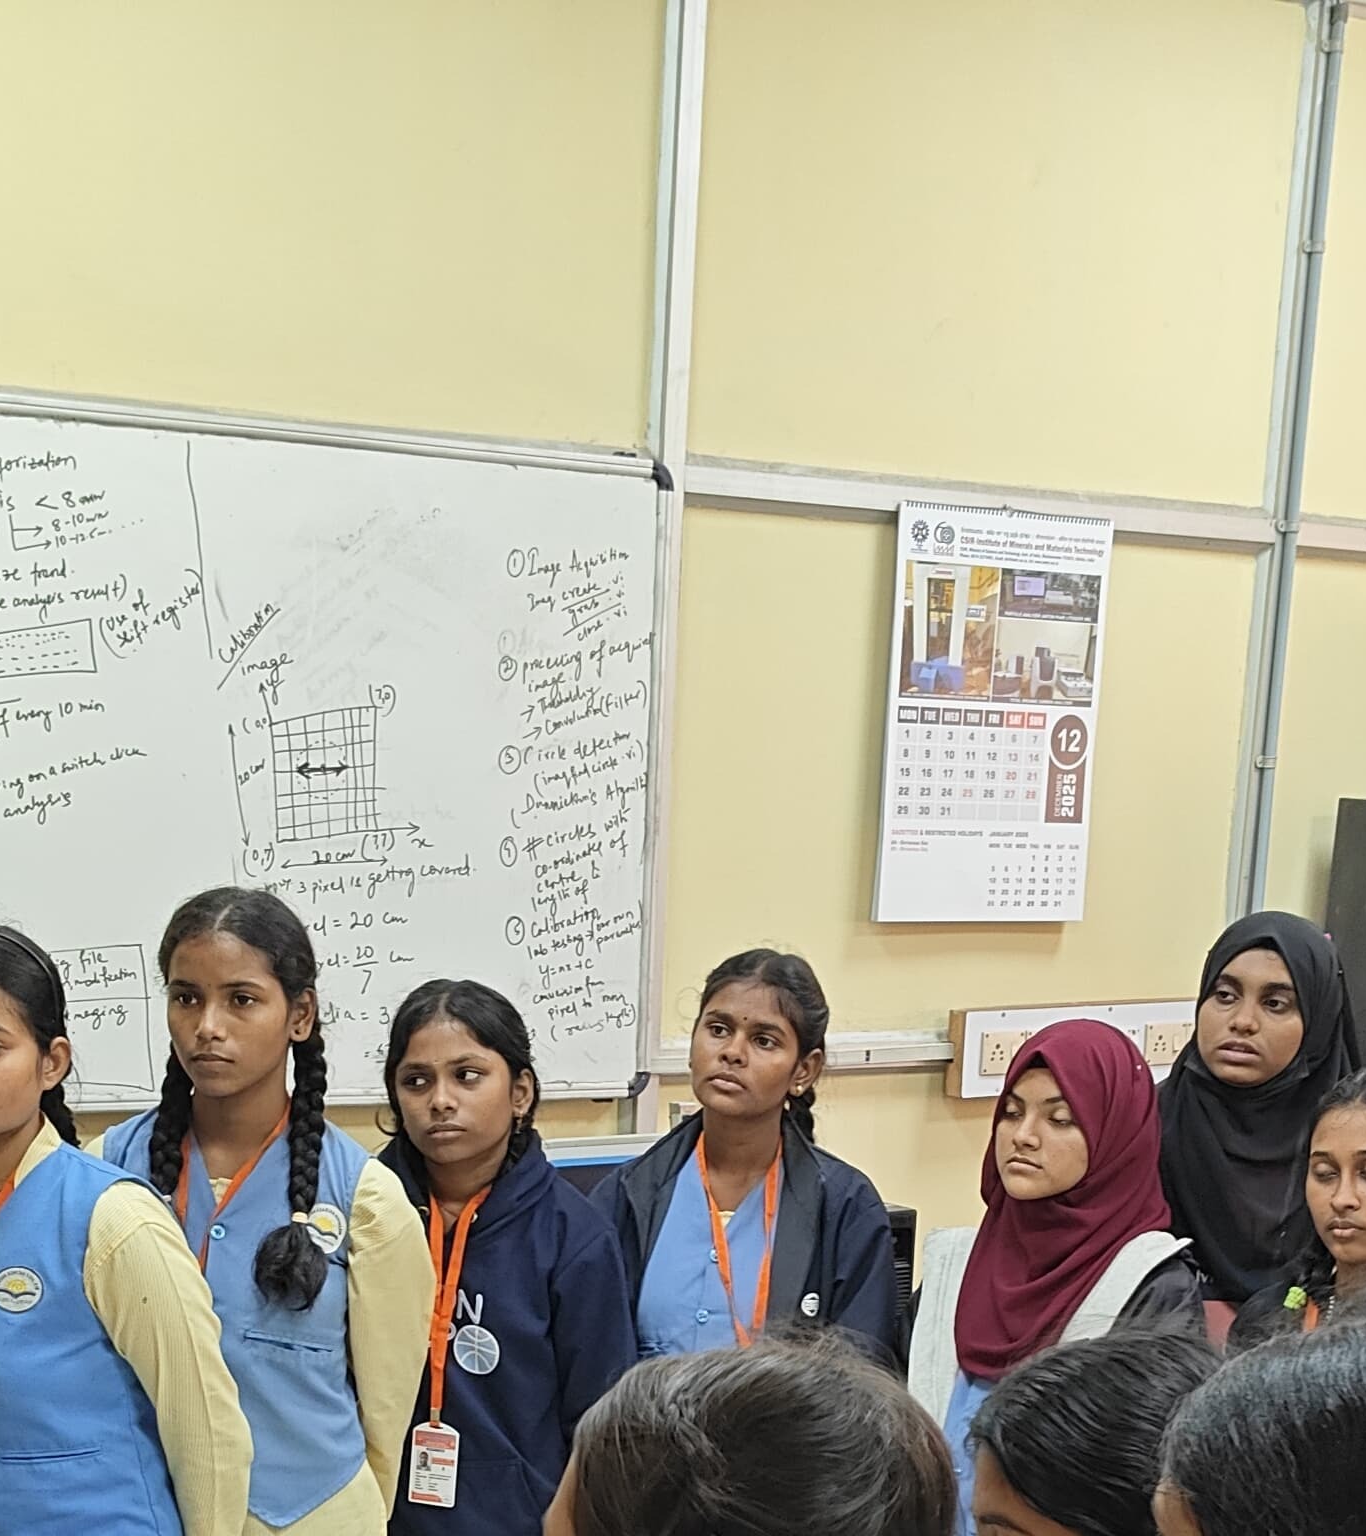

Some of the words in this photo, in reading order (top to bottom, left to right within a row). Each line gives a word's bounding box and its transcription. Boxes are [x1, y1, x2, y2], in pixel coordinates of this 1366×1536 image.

[905, 730, 910, 738] 1
[926, 731, 932, 740] 2
[947, 732, 953, 740] 3
[969, 733, 975, 741] 4
[990, 733, 996, 742] 5
[1032, 735, 1038, 744] 7
[1058, 728, 1082, 752] 12
[903, 749, 909, 758] 8
[925, 750, 930, 758] 9
[945, 751, 955, 759] 10
[966, 752, 976, 760] 11
[987, 752, 997, 761] 12
[1008, 753, 1018, 762] 13
[1029, 754, 1039, 762] 14
[900, 768, 911, 777] 15
[922, 769, 932, 777] 16
[943, 770, 953, 778] 17
[965, 770, 975, 779] 18
[986, 771, 995, 780] 19
[1006, 772, 1017, 780] 20
[1027, 773, 1037, 781] 21
[898, 787, 909, 796] 22
[920, 788, 931, 796] 23
[941, 788, 952, 797] 24
[983, 790, 994, 799] 26
[1004, 790, 1015, 799] 27
[1062, 774, 1077, 817] 2025
[897, 806, 909, 814] 29
[919, 806, 930, 815] 30
[940, 807, 951, 816] 31
[350, 912, 373, 930] 20
